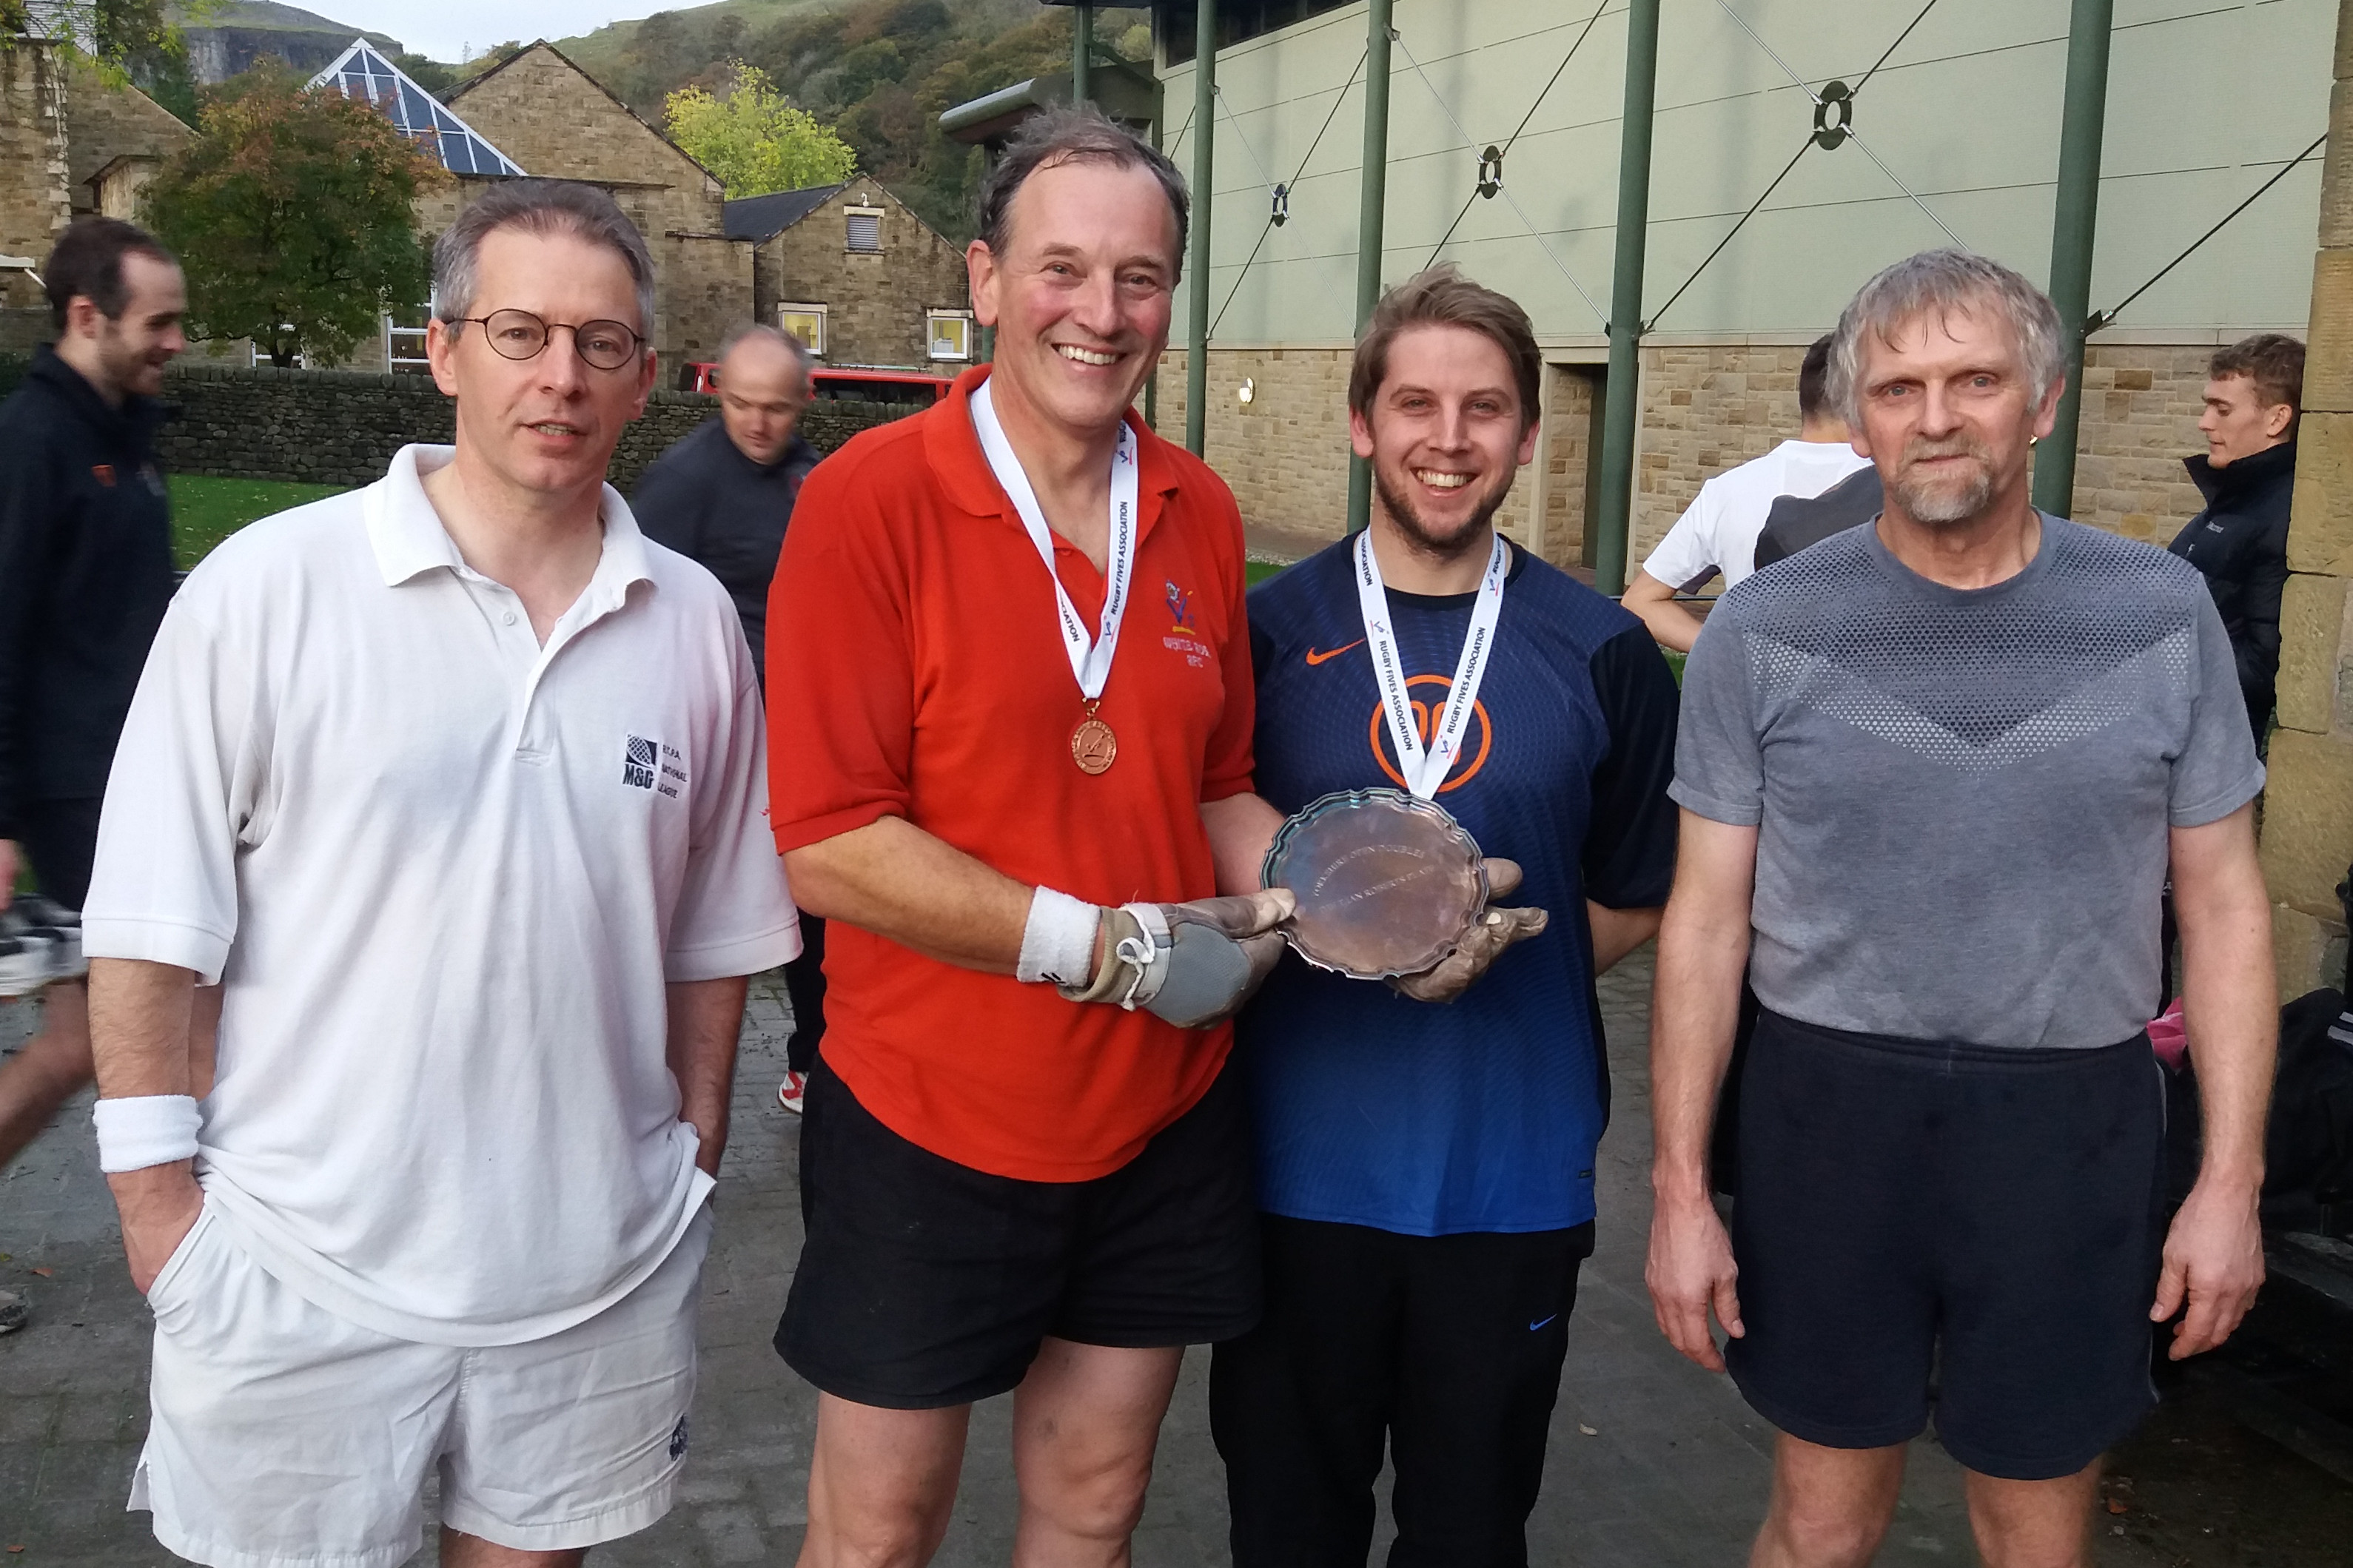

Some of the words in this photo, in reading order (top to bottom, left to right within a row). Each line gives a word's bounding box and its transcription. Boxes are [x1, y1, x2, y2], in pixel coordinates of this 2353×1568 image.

[1118, 501, 1128, 557] ASSOCIATION
[1115, 558, 1125, 583] FIVES
[1111, 582, 1122, 616] RUGBY
[1379, 640, 1392, 668] RUGBY
[1386, 670, 1398, 693] FIVES
[1392, 694, 1414, 751] ASSOCIATION
[1446, 704, 1462, 734] RUGBY
[1457, 680, 1470, 704] FIVES
[1468, 627, 1486, 681] ASSOCIATION
[622, 764, 654, 790] M&G
